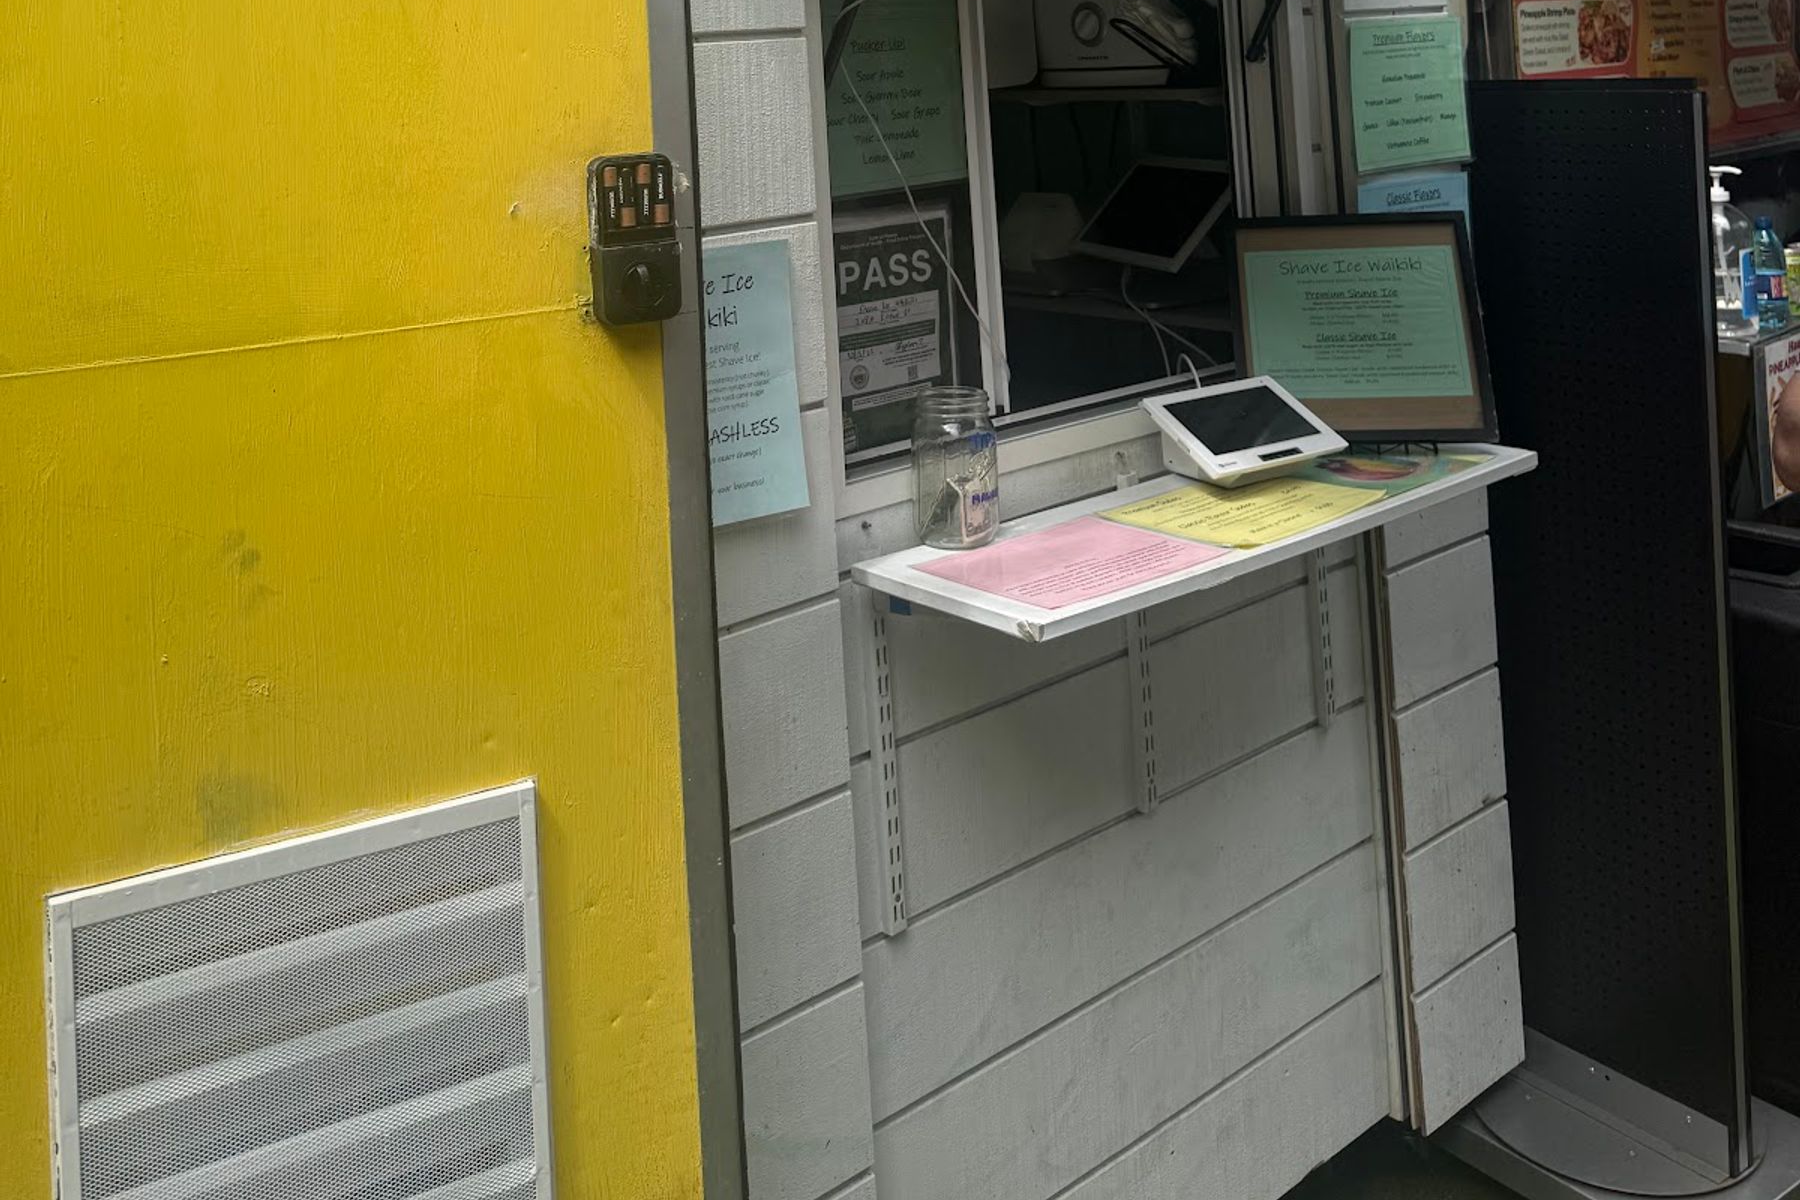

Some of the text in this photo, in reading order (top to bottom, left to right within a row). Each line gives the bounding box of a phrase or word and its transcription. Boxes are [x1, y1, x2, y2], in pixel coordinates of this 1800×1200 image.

[837, 248, 933, 296] PASS
[1278, 259, 1329, 277] Shave
[1334, 259, 1362, 275] Ice
[721, 272, 754, 294] Ice
[707, 305, 738, 329] kiki
[709, 341, 740, 355] serving
[708, 416, 780, 446] ASHLESS
